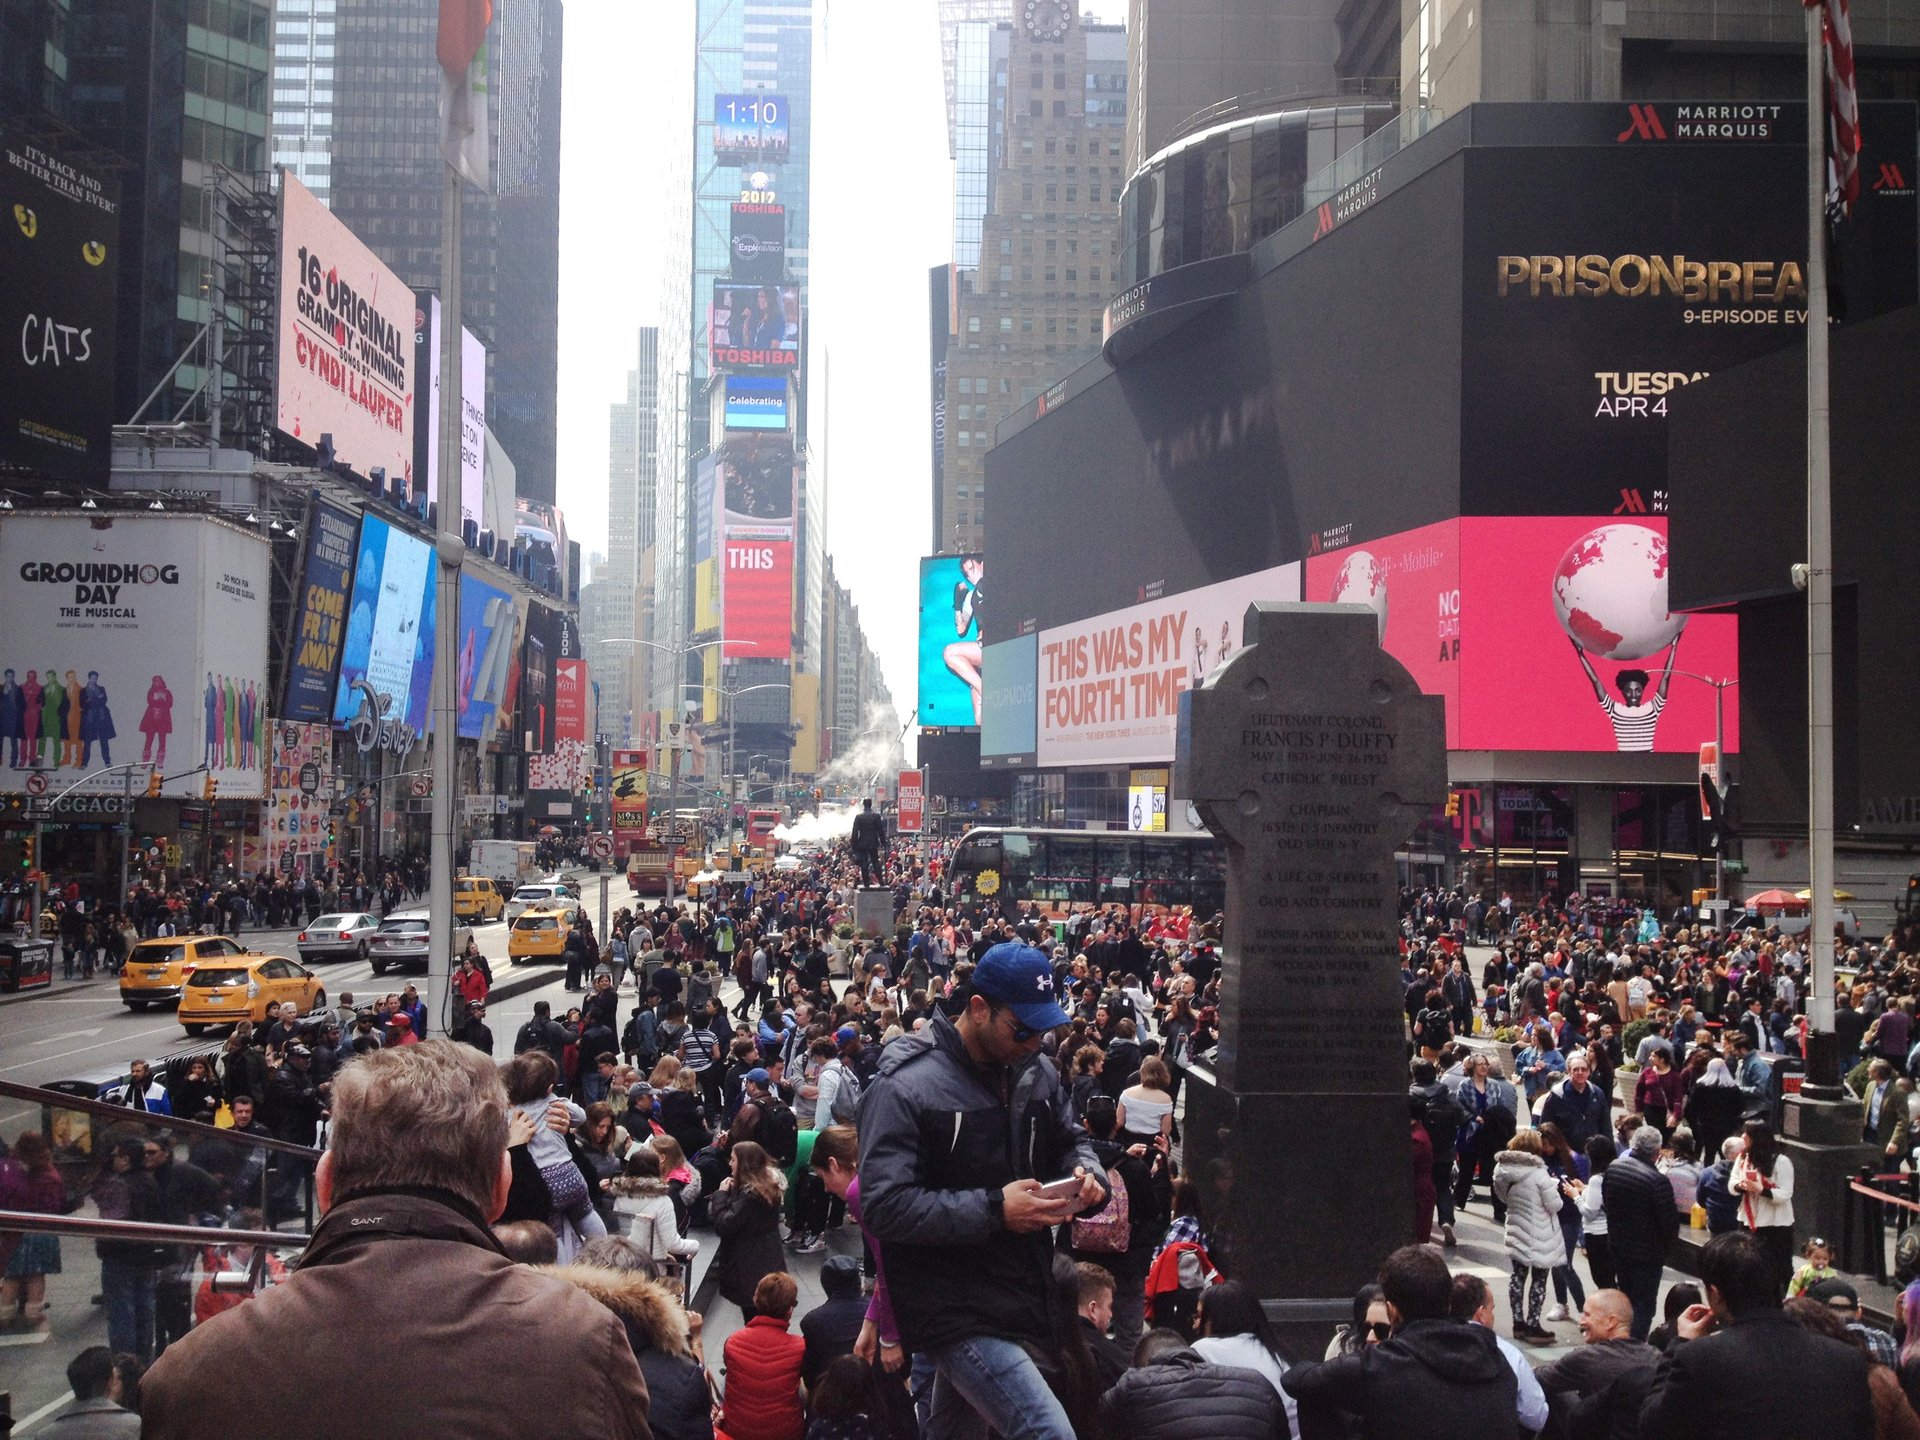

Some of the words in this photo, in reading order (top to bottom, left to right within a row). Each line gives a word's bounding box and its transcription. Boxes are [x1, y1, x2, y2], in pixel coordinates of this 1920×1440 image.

[727, 101, 777, 123] 1:10
[1678, 106, 1780, 119] MARRIOTT
[1677, 124, 1769, 138] MARQUIS
[25, 145, 46, 165] IT'S
[48, 157, 77, 181] BACK
[78, 174, 102, 192] AND
[53, 173, 83, 198] THAN
[1337, 169, 1382, 206] MARRIOTT
[741, 190, 776, 204] 2017
[1337, 188, 1377, 222] MARQUIS
[732, 204, 784, 214] TOSHIBA
[1112, 282, 1152, 311] MARRIOTT
[297, 246, 322, 297] 16
[324, 266, 405, 368] ORIGINAL
[1112, 299, 1146, 326] MARQUIS
[1684, 309, 1779, 324] 9-EPISODE
[22, 312, 92, 367] CATS
[339, 347, 361, 374] SONGS
[361, 366, 371, 380] BY
[715, 349, 797, 364] TOSHIBA
[295, 331, 346, 395] CYNDI
[348, 370, 403, 435] LAUPER
[1045, 380, 1068, 398] MARRIOTT
[728, 396, 783, 407] Celebrating
[1045, 392, 1066, 409] MARQUIS
[1595, 396, 1648, 417] APR
[1651, 396, 1668, 417] 4
[465, 400, 484, 428] THINGS
[171, 488, 208, 498] LAMAR
[1323, 524, 1353, 538] MARRIOTT
[1323, 536, 1349, 549] MARQUIS
[727, 548, 774, 569] THIS
[20, 562, 179, 585] GROUNDHOG
[1146, 579, 1165, 591] MARRIOTT
[75, 584, 121, 605] DAY
[307, 584, 345, 620] COME
[60, 607, 80, 617] THE
[86, 608, 136, 618] MUSICAL
[302, 610, 341, 645] FROM
[561, 621, 569, 656] 1500
[1092, 621, 1143, 675] WAS
[1148, 610, 1188, 665] MY
[297, 640, 337, 673] AWAY
[1045, 677, 1126, 728] FOURTH
[1130, 667, 1187, 720] TIME
[1250, 714, 1323, 727] LIEUTENANT
[1327, 715, 1386, 729] COLONEL
[1241, 730, 1314, 747] FRANCIS
[1337, 732, 1398, 749] DUFFY
[1251, 752, 1274, 762] MAY
[1316, 753, 1344, 764] JUNE
[1261, 772, 1322, 785] CATHOLIC
[1331, 774, 1377, 787] PRIEST
[1289, 804, 1350, 816] CHAPLAIN
[1322, 823, 1378, 834] INFANTRY
[1277, 838, 1303, 849] OLD
[1278, 871, 1303, 883] LIFE
[1307, 872, 1323, 883] OF
[1329, 872, 1380, 884] SERVICE
[1258, 896, 1288, 908] GOD
[1293, 897, 1319, 908] AND
[1323, 897, 1383, 909] COUNTRY
[1255, 929, 1299, 939] SPANISH
[1302, 930, 1360, 940] AMERICAN
[1361, 931, 1385, 940] WAR
[350, 1216, 383, 1226] GANT
